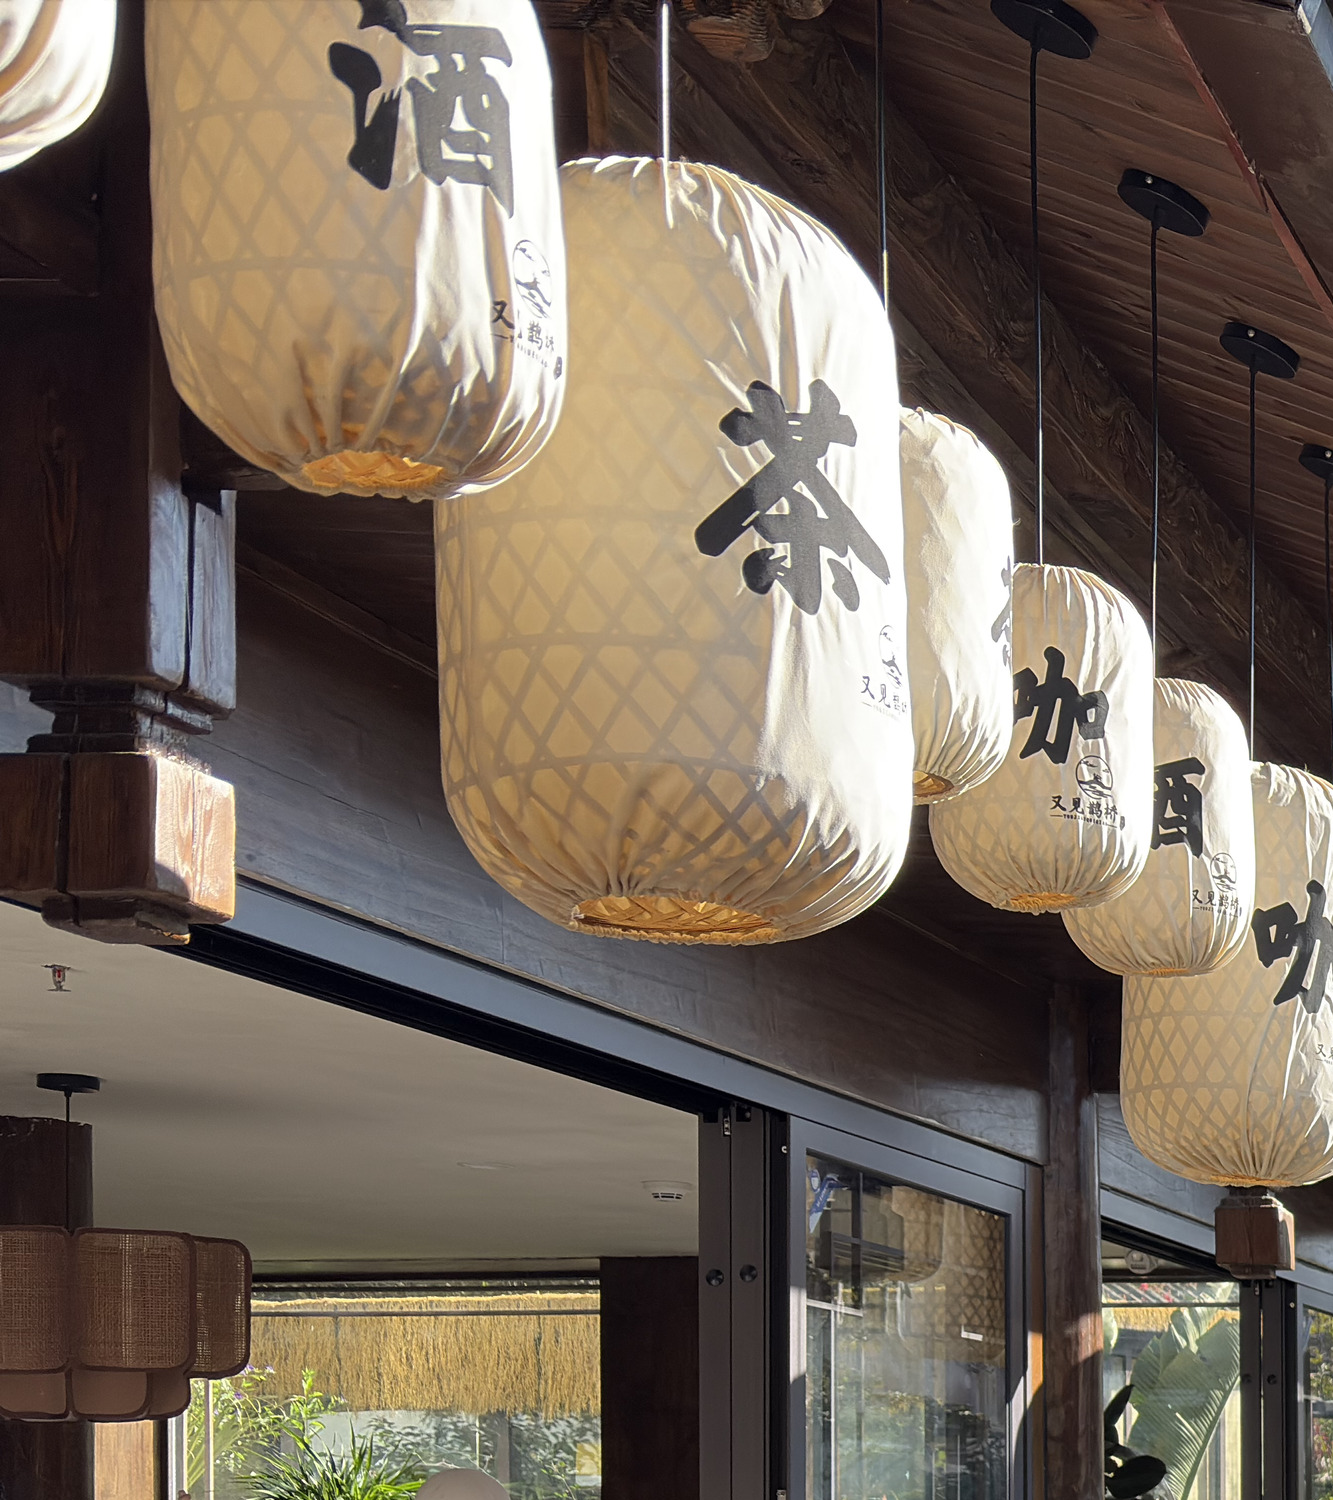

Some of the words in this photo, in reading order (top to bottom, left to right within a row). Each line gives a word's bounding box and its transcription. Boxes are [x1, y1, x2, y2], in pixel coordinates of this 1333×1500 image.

[328, 0, 515, 219] 酒
[694, 378, 891, 616] 茶
[1012, 646, 1110, 765] 咖
[1050, 794, 1119, 824] 又见鹊桥
